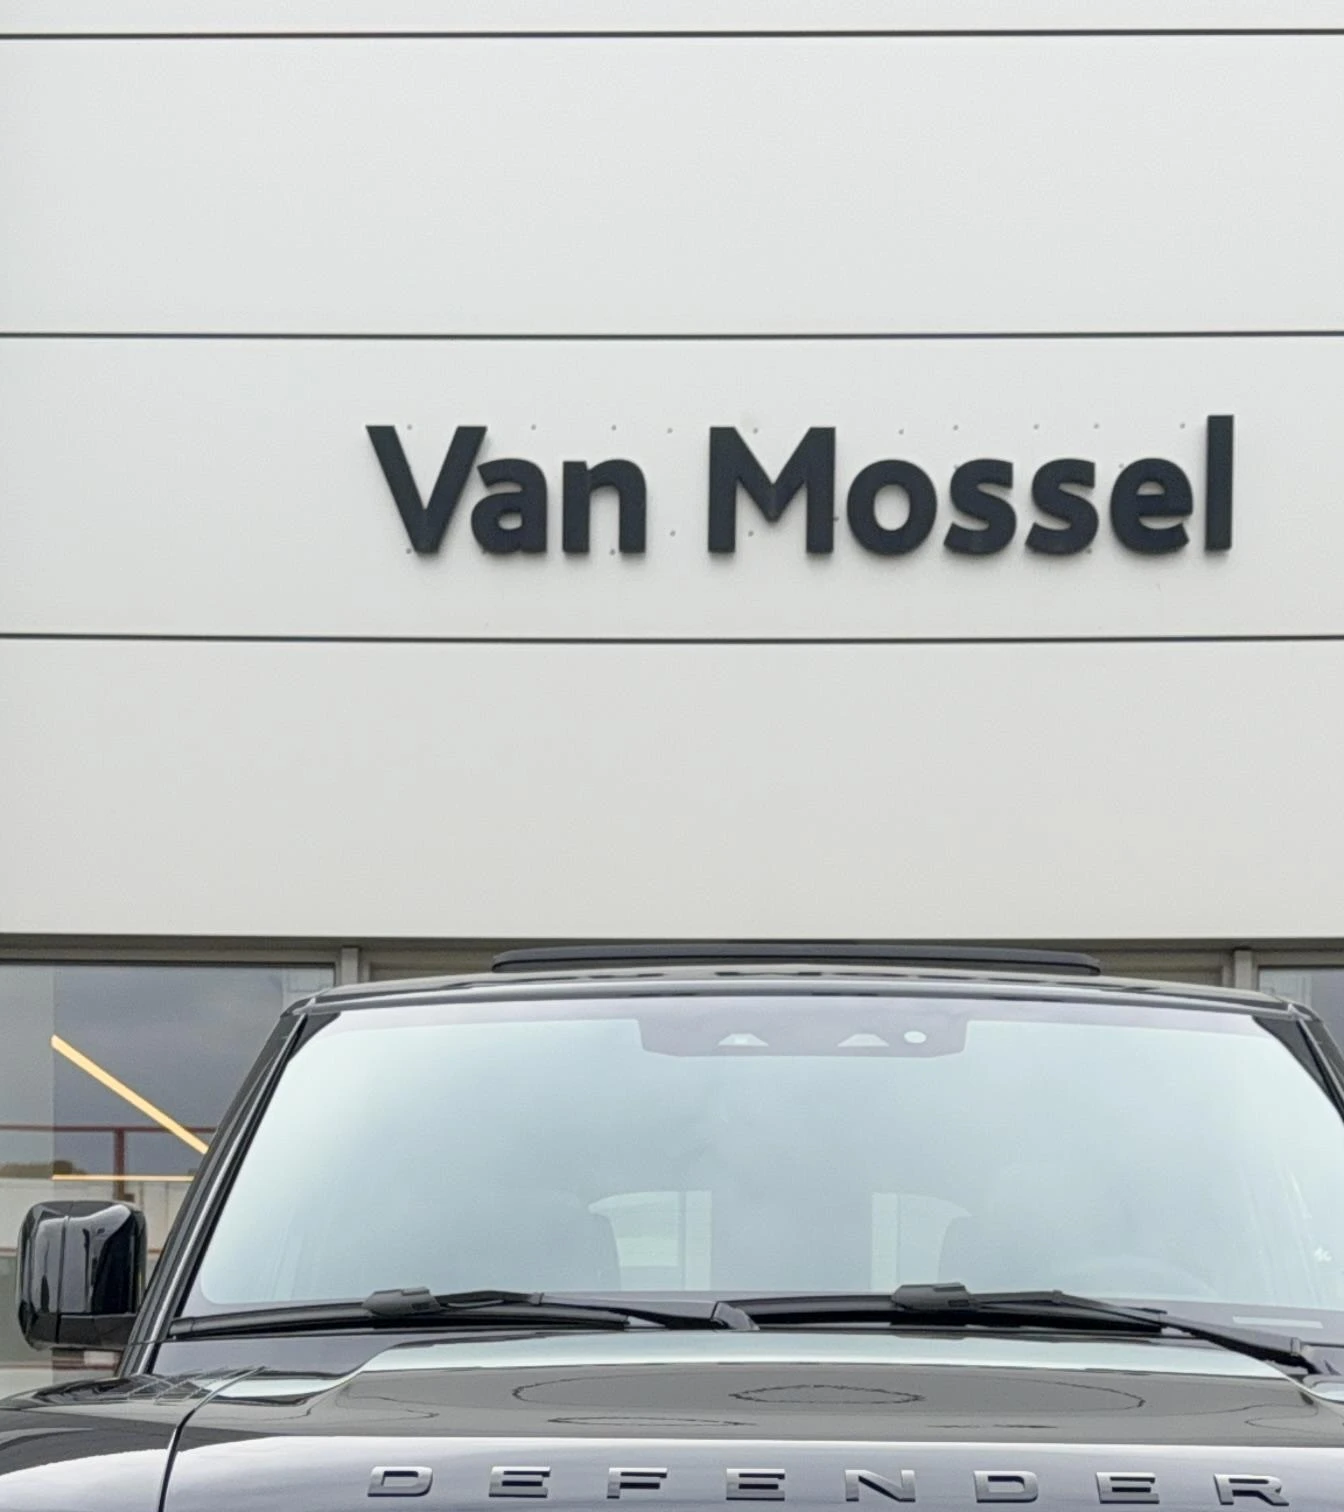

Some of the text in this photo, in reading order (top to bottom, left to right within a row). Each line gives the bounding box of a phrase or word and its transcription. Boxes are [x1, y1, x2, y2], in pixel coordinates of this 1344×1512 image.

[366, 414, 1235, 555] Van Mossel
[367, 1465, 1290, 1507] DEFENDER
